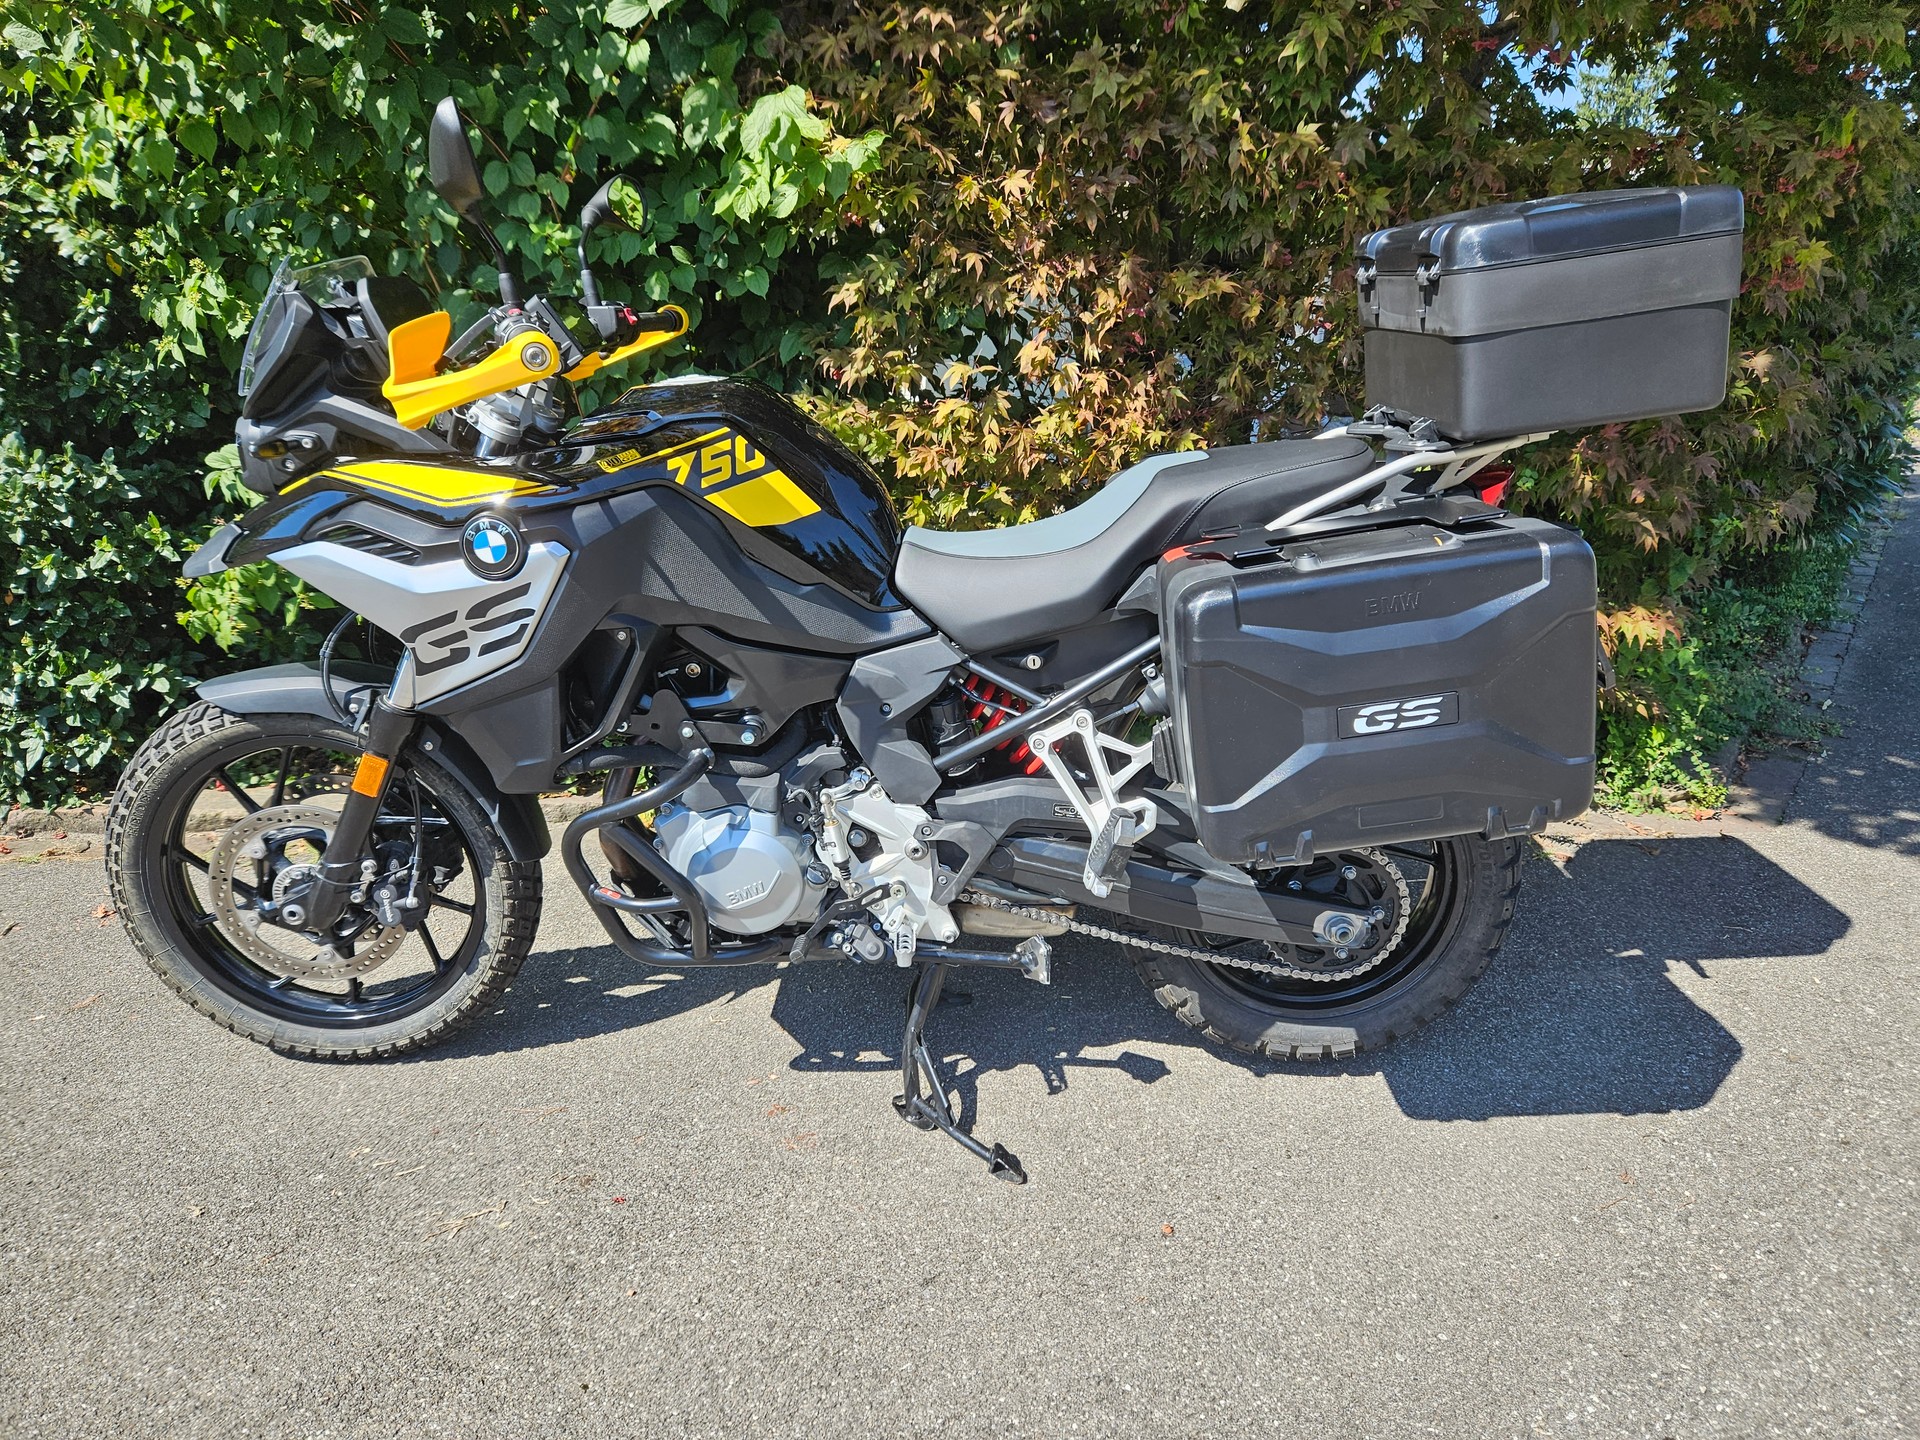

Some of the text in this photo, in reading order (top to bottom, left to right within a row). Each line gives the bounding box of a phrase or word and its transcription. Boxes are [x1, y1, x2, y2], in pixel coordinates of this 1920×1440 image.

[667, 434, 766, 489] 750
[466, 520, 509, 542] BMW
[1365, 591, 1421, 617] BMW
[400, 582, 536, 676] GS
[1353, 696, 1443, 734] GS
[726, 880, 766, 905] BMW
